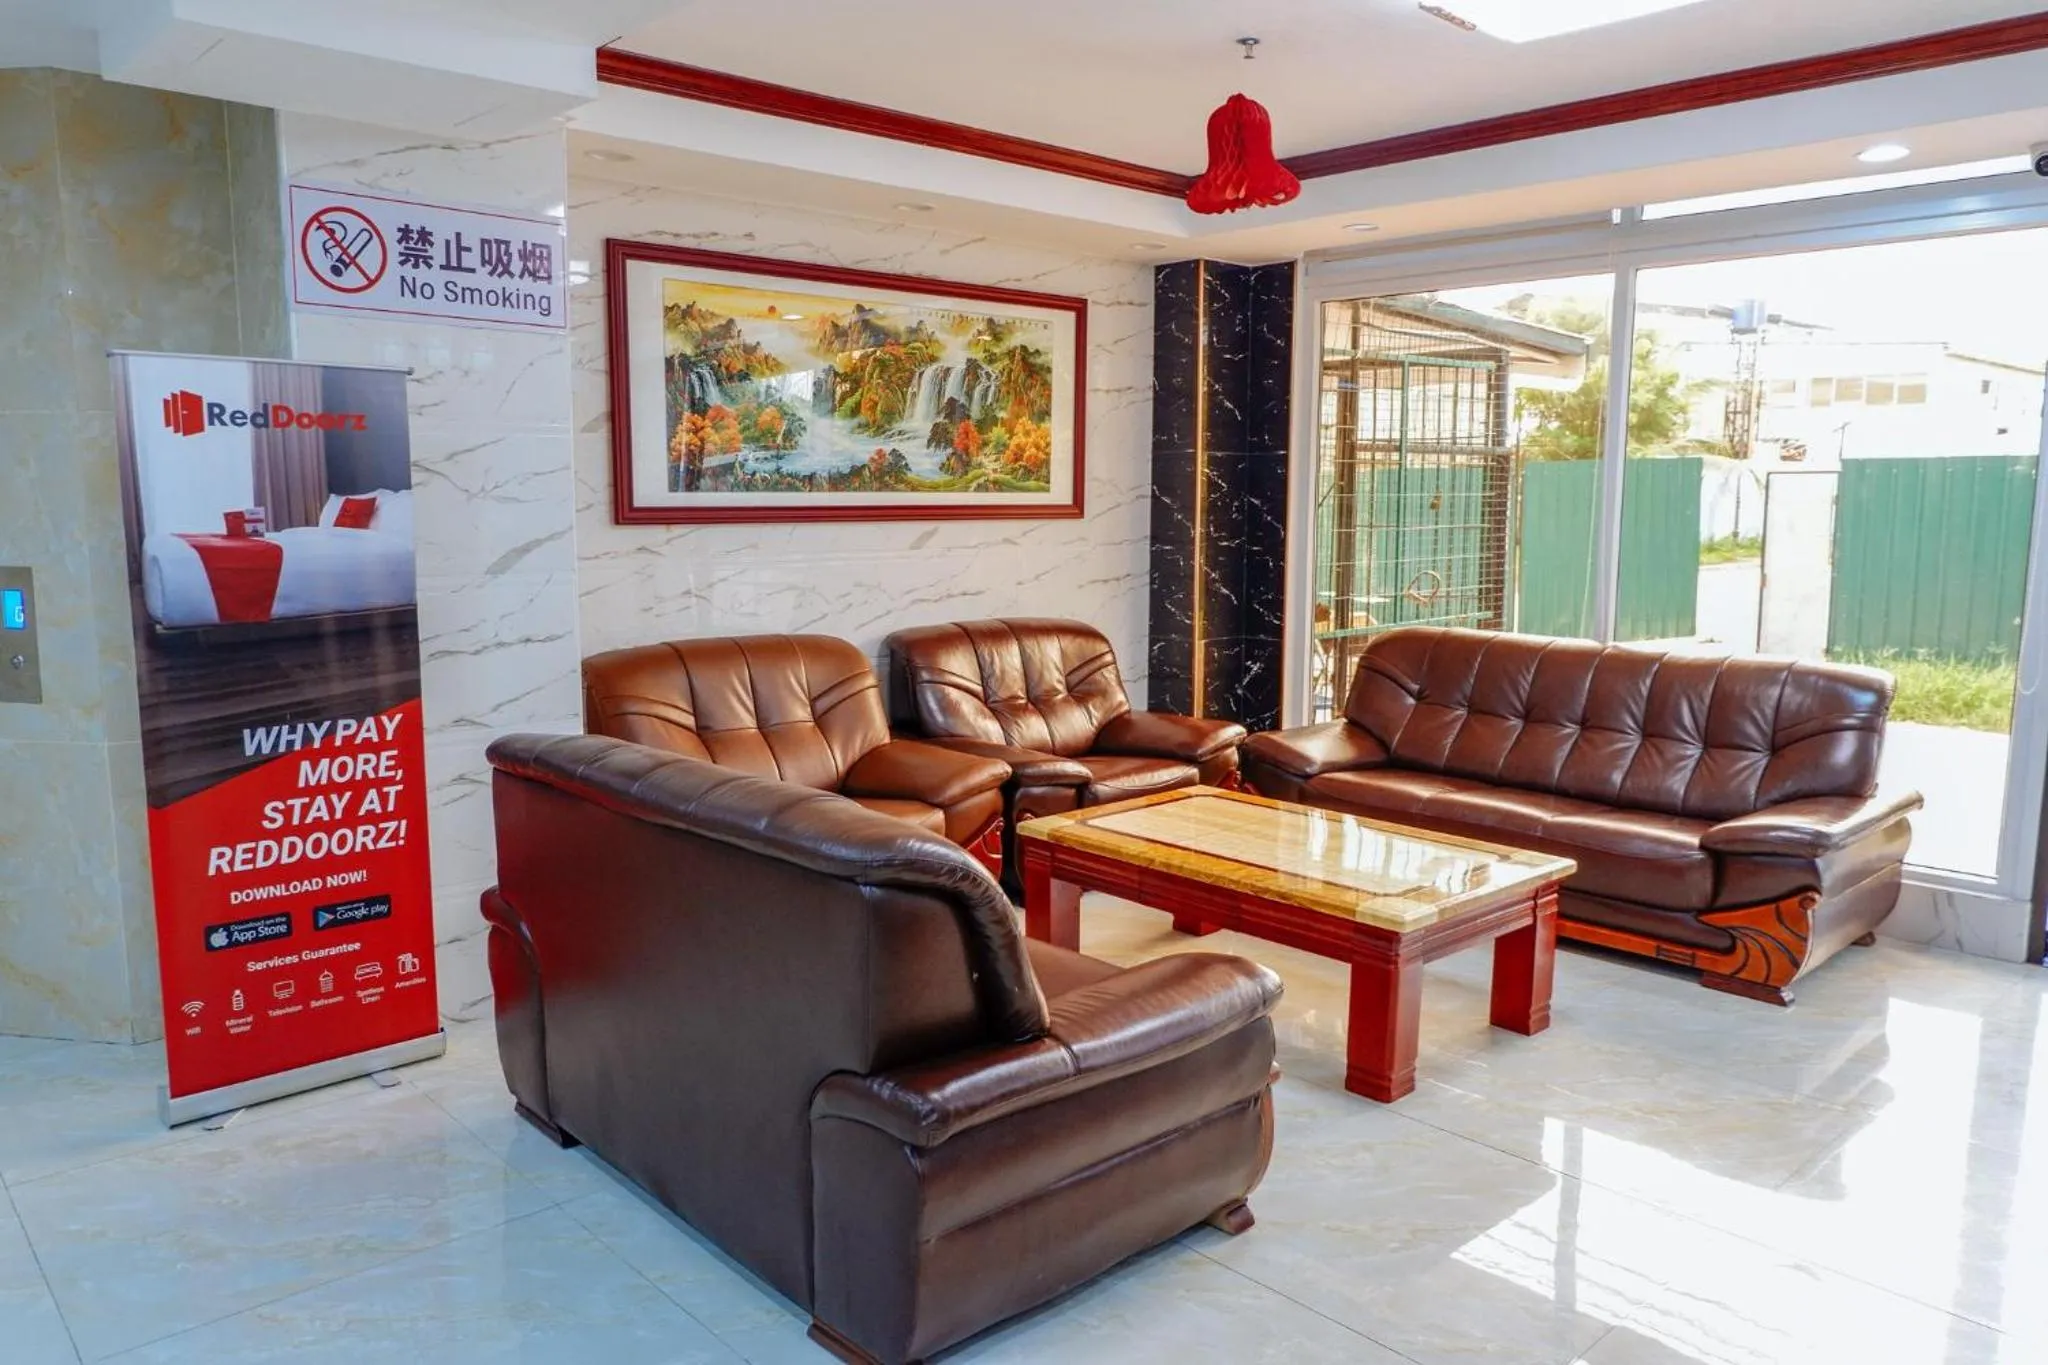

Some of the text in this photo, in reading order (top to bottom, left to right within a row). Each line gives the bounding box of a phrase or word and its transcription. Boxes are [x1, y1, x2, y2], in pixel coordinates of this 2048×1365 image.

[397, 223, 552, 284] 禁止吸烟
[400, 275, 552, 317] No Smoking
[206, 402, 368, 431] RedDoorz
[243, 713, 403, 757] WHY PAY
[297, 749, 403, 788] MORE,
[261, 784, 404, 829] STAY AT
[207, 818, 408, 876] REDDOORZ!
[230, 869, 368, 904] DOWNLOAD NOW!
[336, 905, 370, 919] Google
[231, 923, 288, 943] App Store
[247, 942, 362, 972] Services Guarantee
